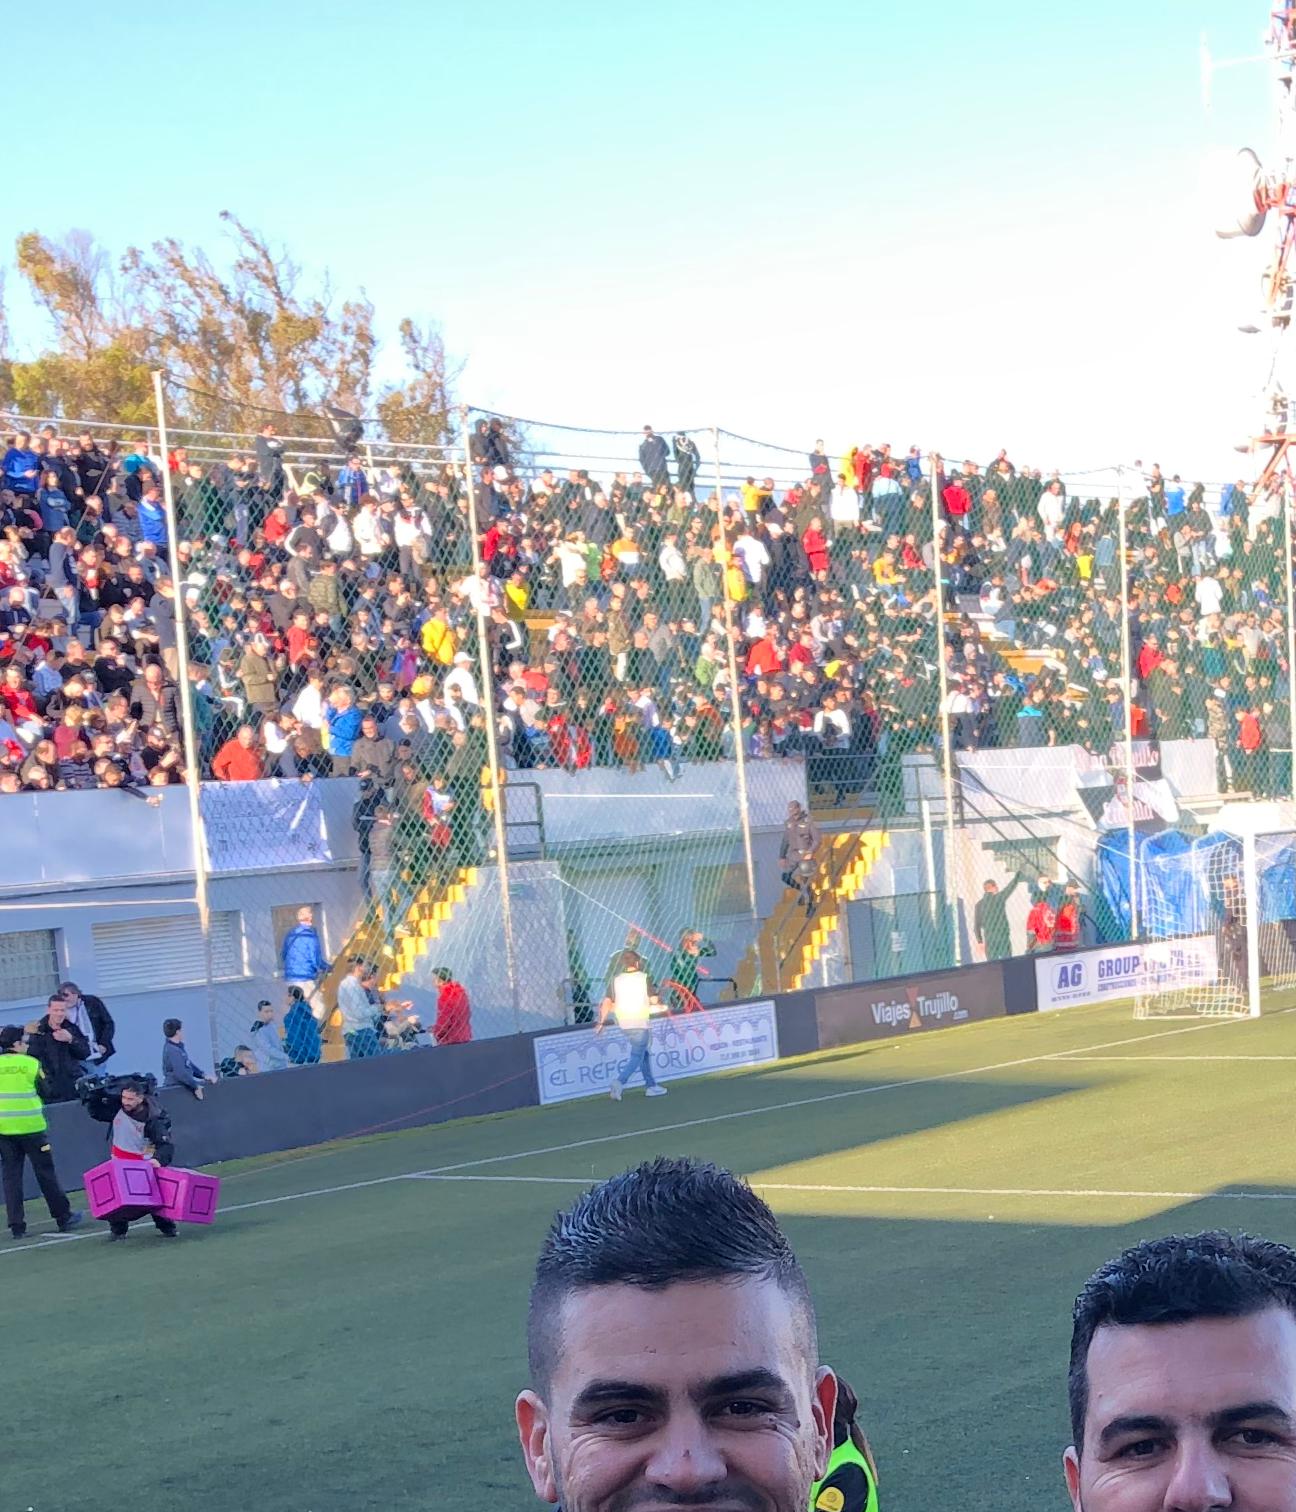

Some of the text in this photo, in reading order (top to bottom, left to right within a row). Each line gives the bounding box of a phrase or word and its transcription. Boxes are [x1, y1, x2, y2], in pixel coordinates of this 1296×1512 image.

[1057, 963, 1082, 989] AG
[1098, 955, 1140, 979] GROUP
[871, 991, 958, 1027] Viajes Trujillo
[550, 1068, 575, 1086] EL
[578, 1045, 705, 1084] REFEORIO
